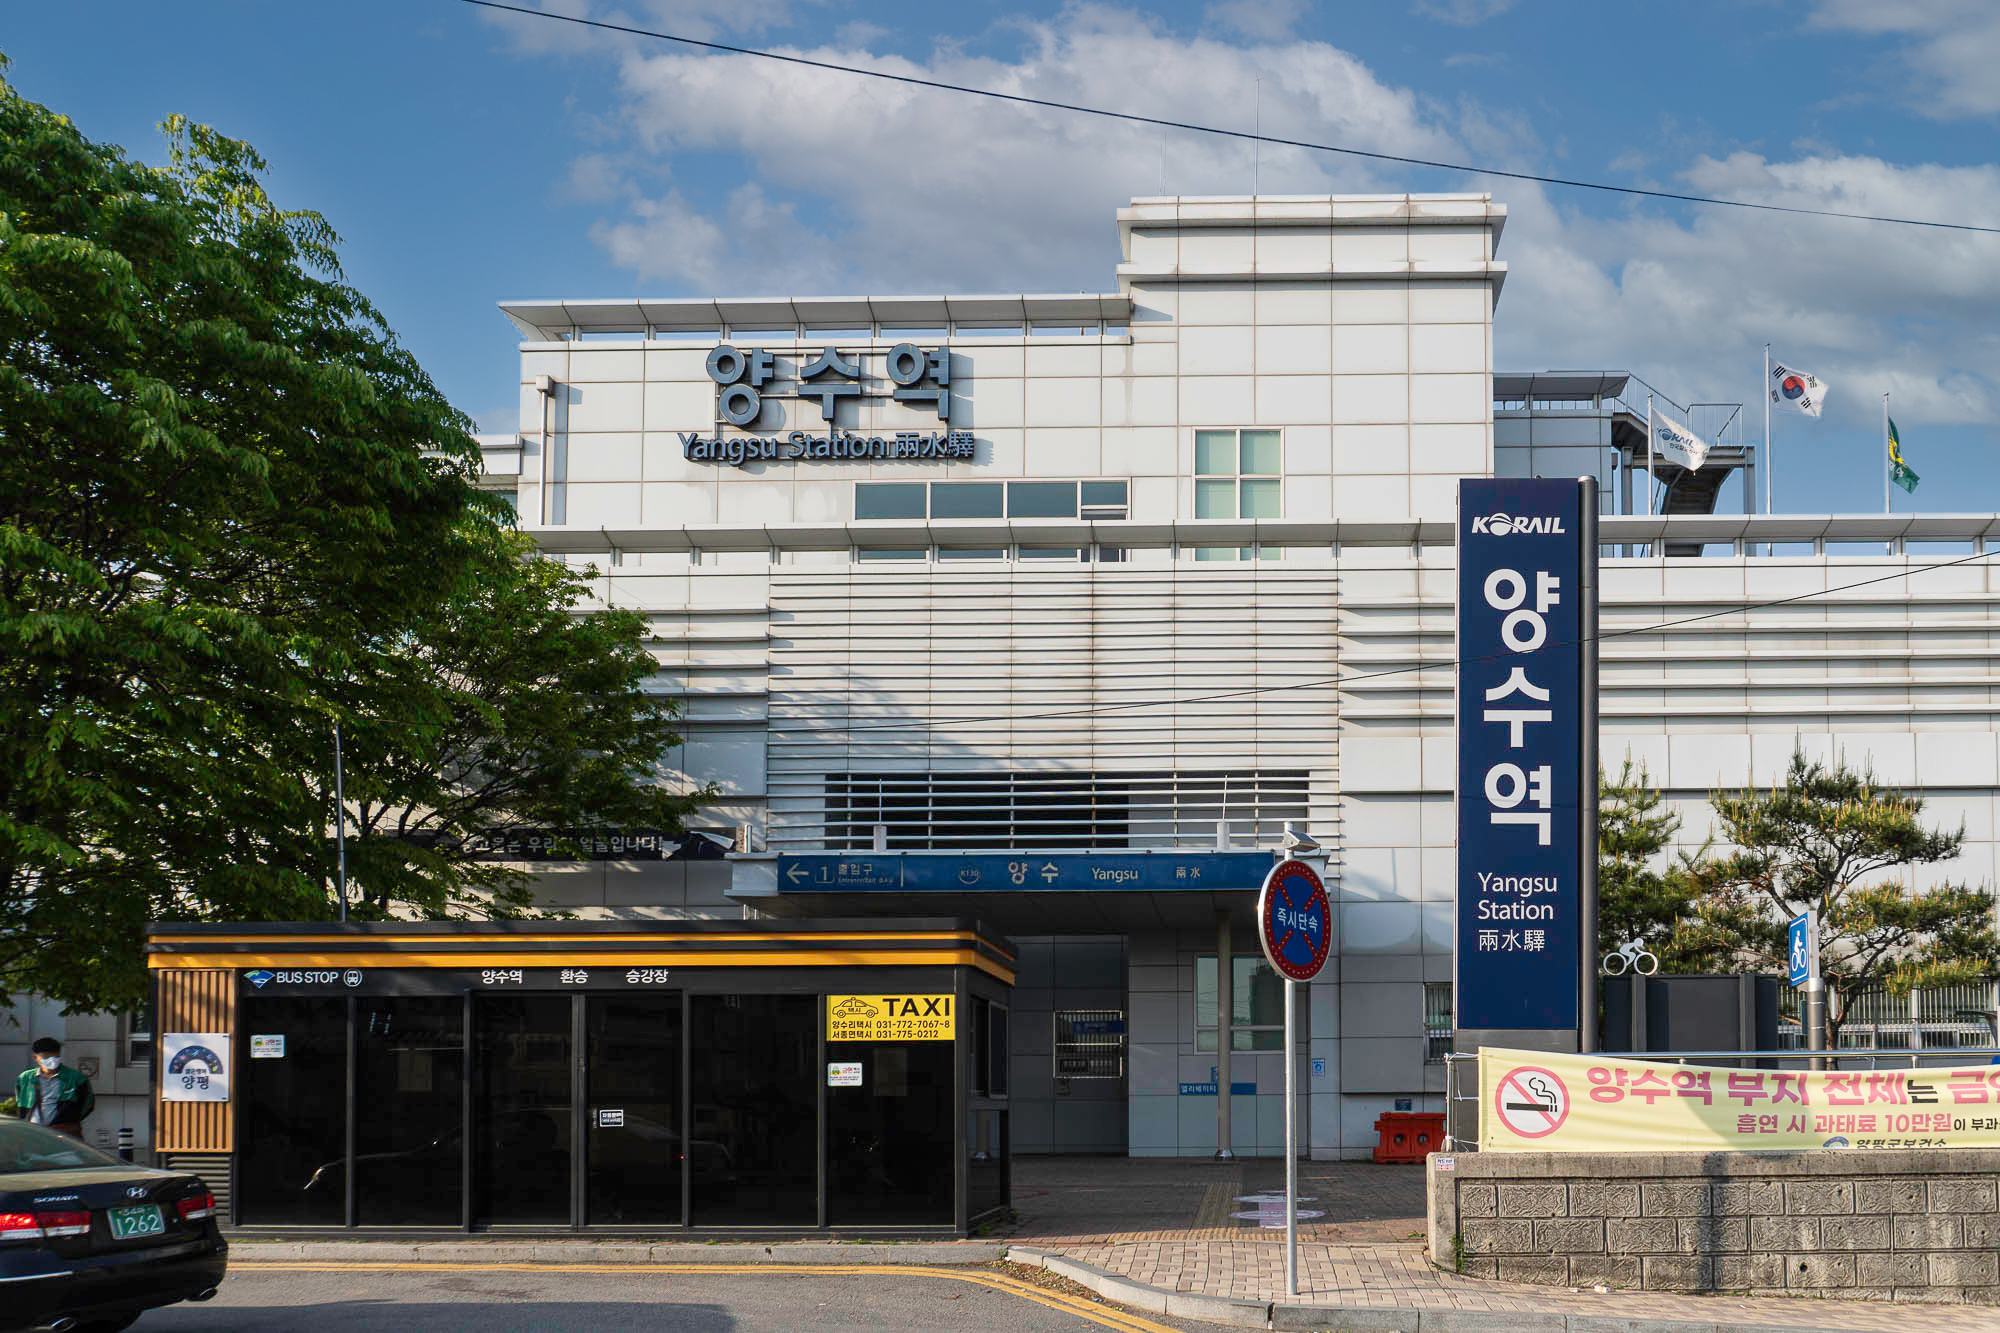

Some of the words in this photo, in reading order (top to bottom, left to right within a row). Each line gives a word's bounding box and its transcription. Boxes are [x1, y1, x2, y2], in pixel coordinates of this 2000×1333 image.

[706, 343, 950, 427] 양수역
[677, 432, 777, 467] Yangsu
[788, 431, 886, 458] Station
[895, 431, 975, 457] 兩水驛
[1472, 513, 1565, 536] KORAIL
[1483, 568, 1560, 846] 양수역
[819, 865, 828, 881] 1
[1092, 867, 1139, 883] Yangsu
[1477, 872, 1557, 897] Yangsu
[1277, 907, 1318, 933] 즉시단속
[1478, 900, 1554, 920] Station
[1478, 929, 1545, 952] 兩水驛
[276, 970, 303, 984] BUS
[304, 970, 339, 984] STOP
[481, 969, 523, 985] 양수역
[560, 969, 589, 985] 환승
[625, 969, 669, 985] 승강장
[882, 998, 950, 1017] TAXI
[832, 1020, 872, 1030] 양수리택시
[876, 1020, 950, 1029] 031-772-7067~8
[876, 1030, 939, 1039] 031-775-0212
[181, 1075, 209, 1090] 양평
[1587, 1067, 1713, 1106] 양수역
[1728, 1072, 1811, 1107] 부지
[1823, 1072, 1939, 1106] 전체는
[1737, 1114, 1778, 1134] 흡연
[1786, 1115, 1806, 1134] 시
[1814, 1114, 1878, 1134] 과태료
[1971, 1118, 2000, 1132] 부과
[116, 1214, 161, 1236] 1262
